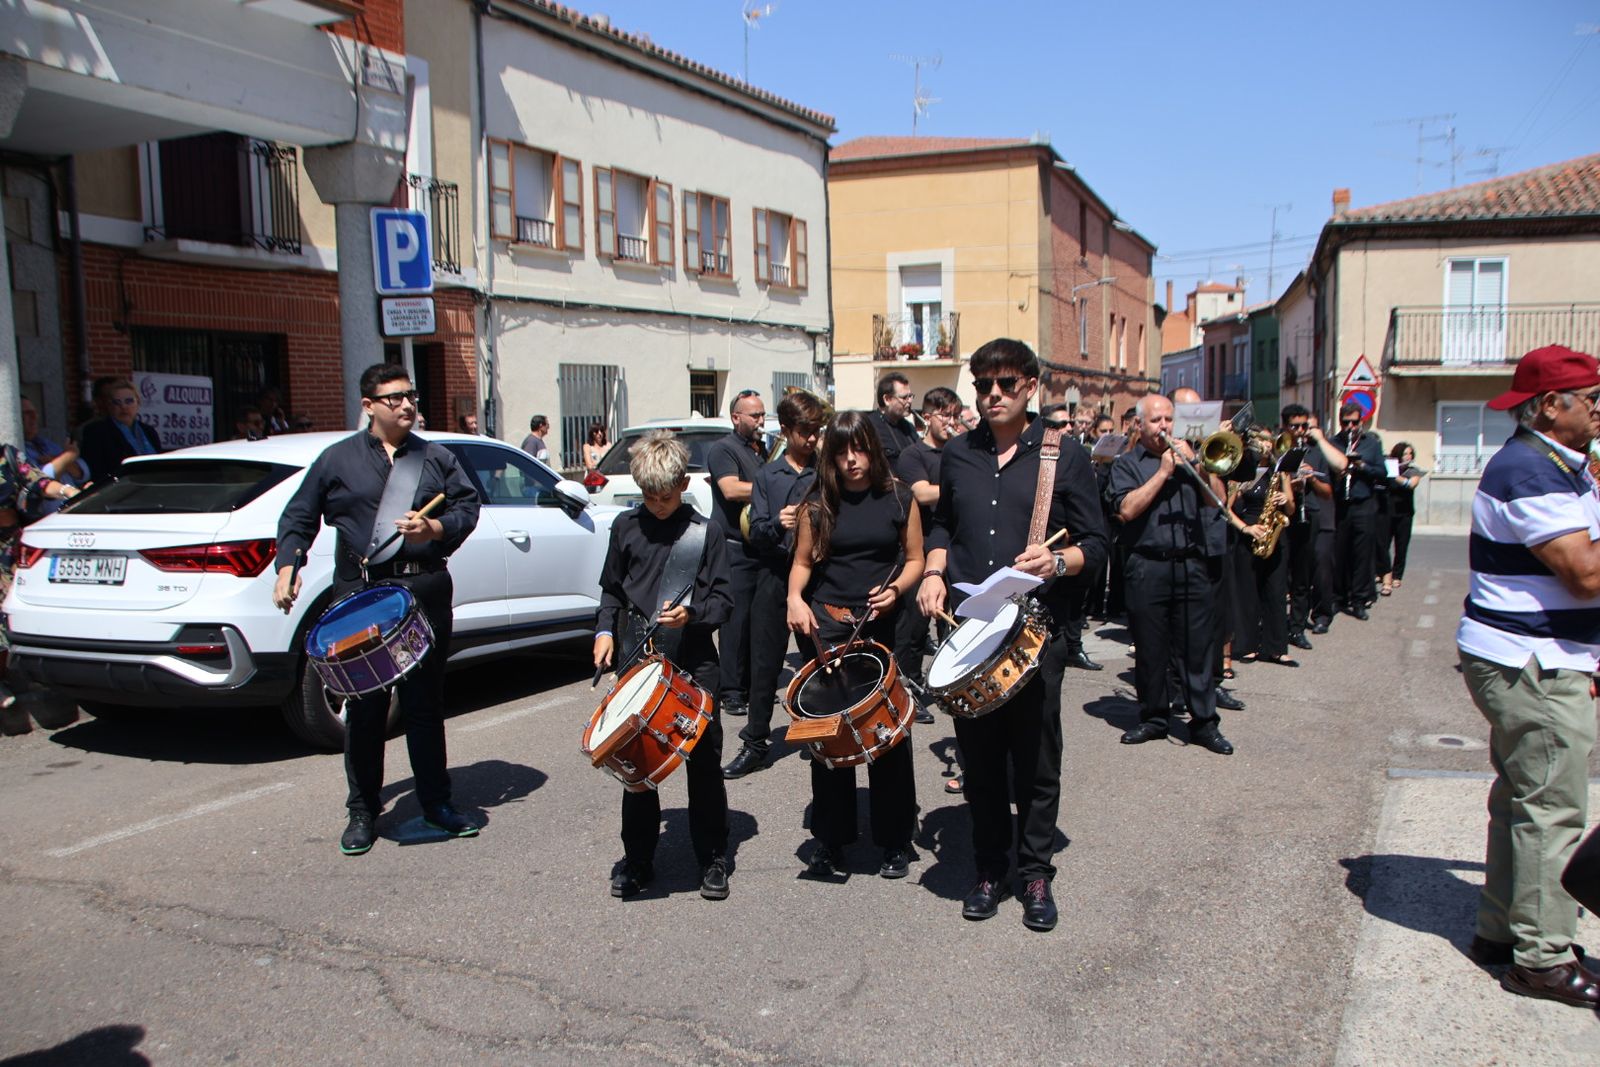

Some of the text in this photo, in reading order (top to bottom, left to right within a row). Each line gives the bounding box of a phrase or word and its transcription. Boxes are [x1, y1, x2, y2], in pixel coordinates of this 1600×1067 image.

[384, 219, 419, 288] P
[168, 387, 210, 403] ALQUILA
[189, 415, 210, 429] 834
[162, 431, 210, 446] 306 050
[59, 558, 123, 578] 5595 MNH
